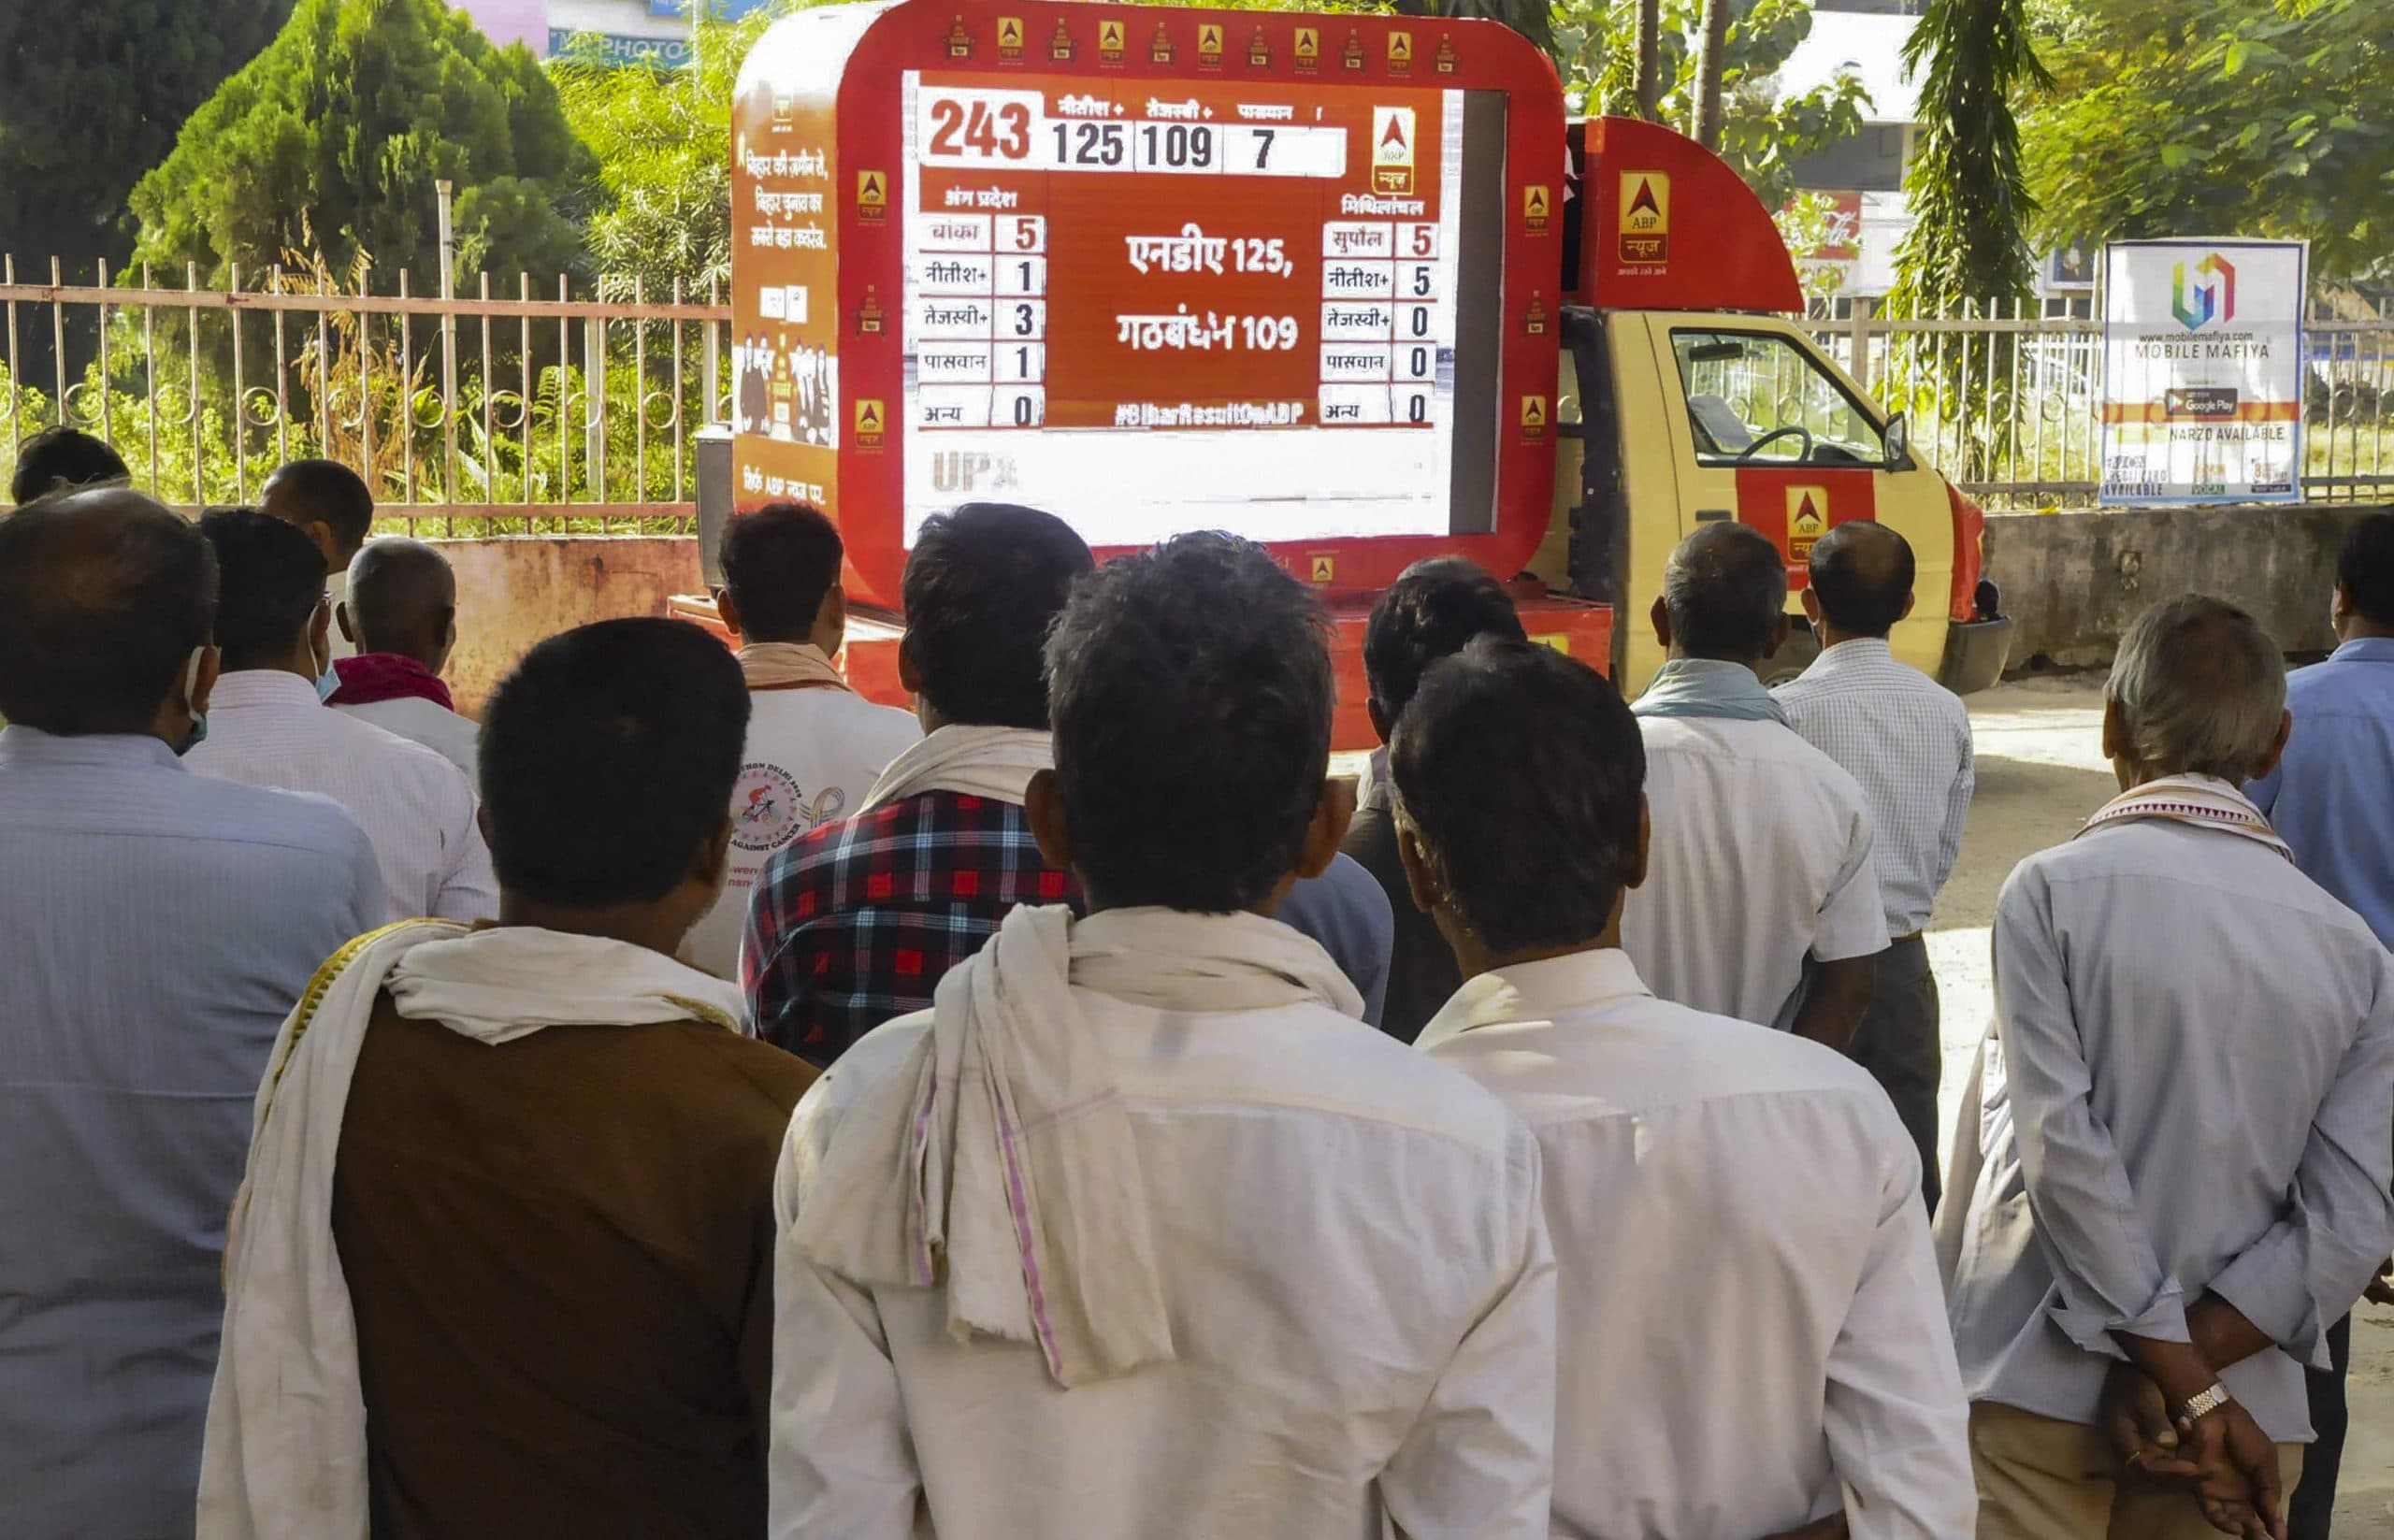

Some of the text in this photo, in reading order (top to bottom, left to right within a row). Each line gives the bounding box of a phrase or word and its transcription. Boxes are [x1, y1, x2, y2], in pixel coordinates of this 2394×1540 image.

[1058, 94, 1111, 117] नीतीश
[930, 99, 1031, 160] 243
[1053, 122, 1123, 166] 125
[1142, 125, 1212, 167] 109
[1252, 130, 1275, 168] 7
[976, 184, 1017, 209] प्रदेश
[1016, 218, 1036, 250] 5
[1632, 216, 1657, 230] ABP
[1125, 223, 1293, 278] एनडीए 125,
[1412, 225, 1432, 255] 5
[1018, 262, 1030, 292] 1
[1413, 266, 1430, 296] 5
[1016, 304, 1032, 336] 3
[1116, 302, 1298, 351] गठबंधन 109
[1412, 307, 1428, 337] 0
[2140, 331, 2253, 342] www.mobilemafiya.com
[924, 354, 987, 369] पासवान
[1016, 347, 1028, 378] 1
[1326, 355, 1386, 370] पासवान
[1411, 347, 1426, 377] 0
[2136, 345, 2270, 359] MOBILE MAFIYA
[925, 406, 963, 422] अन्य
[1015, 396, 1032, 425] 0
[1325, 404, 1361, 419] अन्य
[1409, 395, 1425, 423] 0
[2185, 399, 2233, 413] Google Play
[2170, 427, 2212, 440] NARZO
[2216, 426, 2285, 440] AVAILABLE
[1799, 524, 1819, 534] ABP
[768, 764, 793, 781] DELHI
[731, 824, 800, 851] AGAINST CANCER
